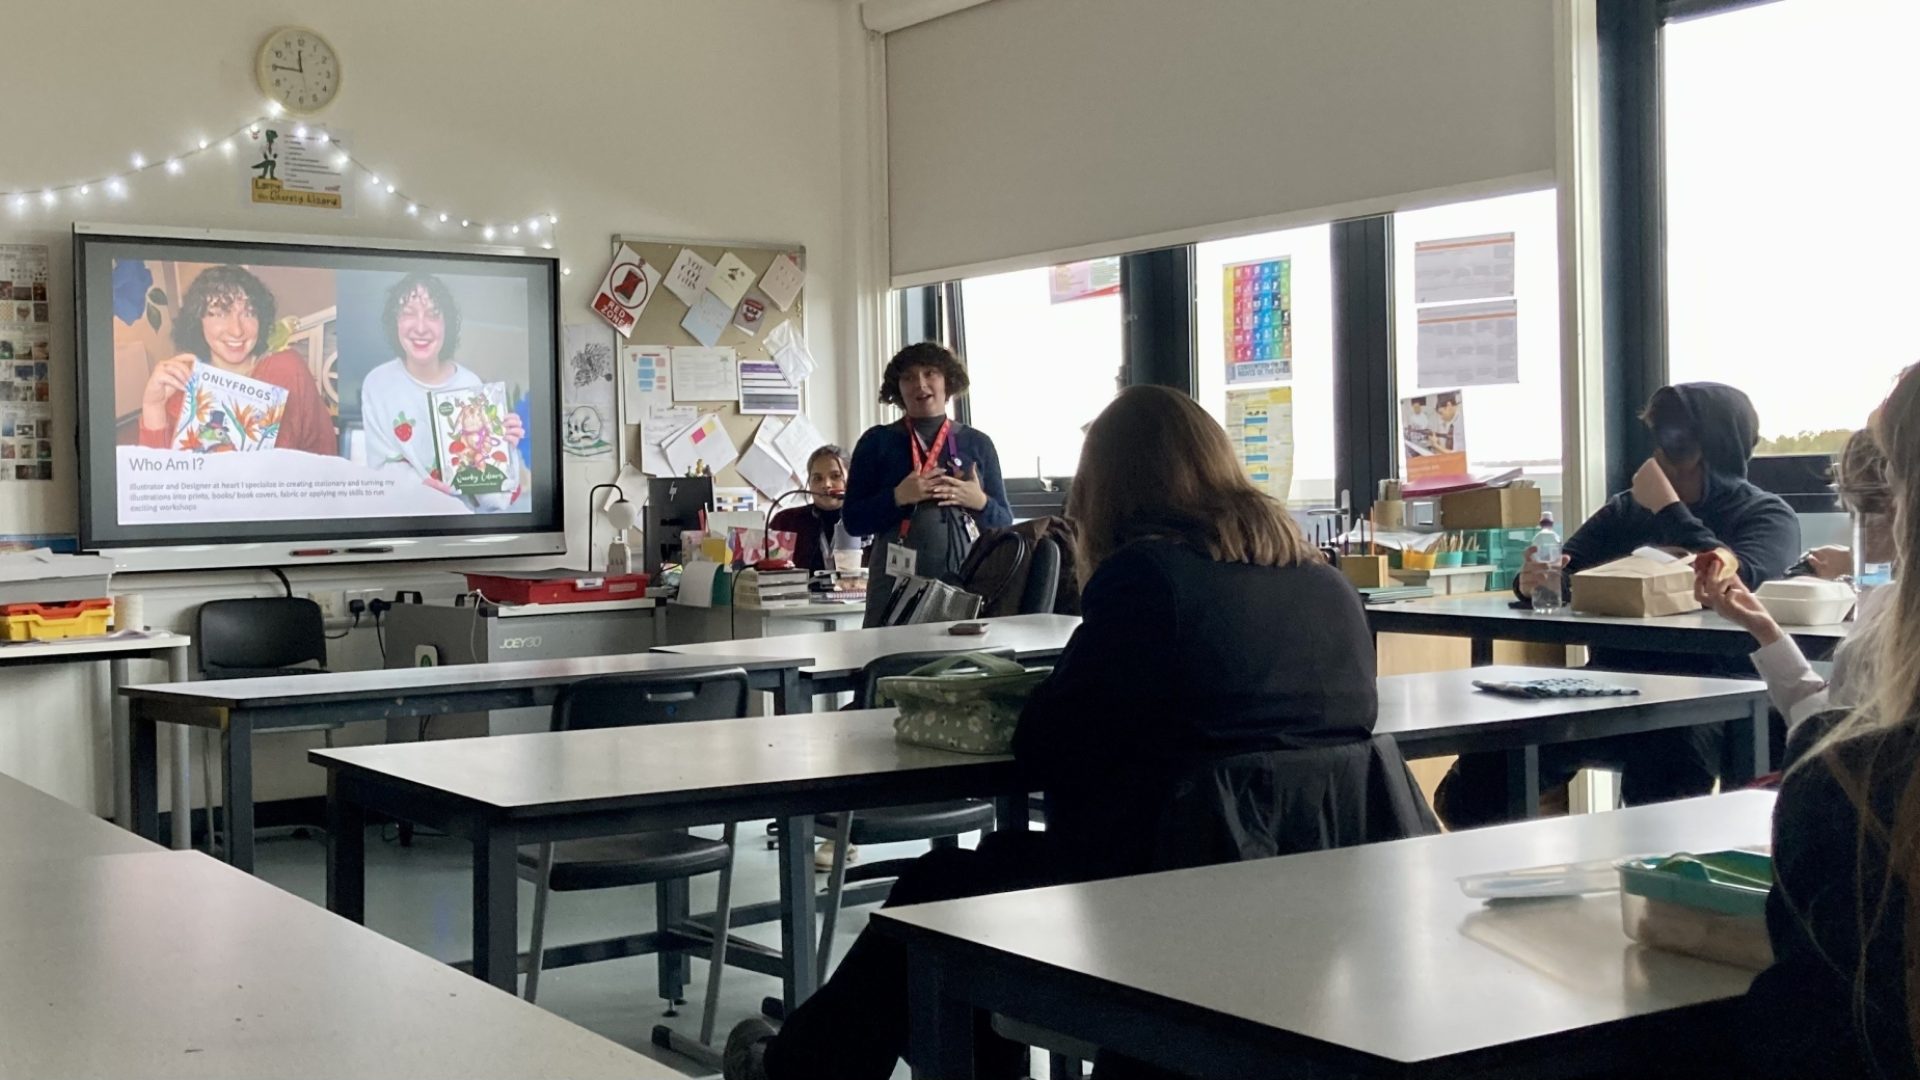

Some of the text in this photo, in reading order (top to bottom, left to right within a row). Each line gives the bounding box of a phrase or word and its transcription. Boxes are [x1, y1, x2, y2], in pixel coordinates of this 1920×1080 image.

[601, 304, 625, 327] ZONE
[608, 300, 625, 318] RED
[201, 371, 272, 401] ONLYFROGS
[129, 457, 205, 471] Who Am I?
[129, 483, 164, 491] Illustrator
[181, 482, 211, 492] Designer
[221, 481, 240, 489] heart
[286, 480, 312, 489] creating
[314, 480, 346, 488] stationary
[361, 479, 384, 488] turning
[237, 491, 254, 499] book
[280, 490, 298, 498] fabric
[309, 490, 336, 498] applying
[338, 490, 347, 498] my
[130, 503, 197, 512] exciting workshops
